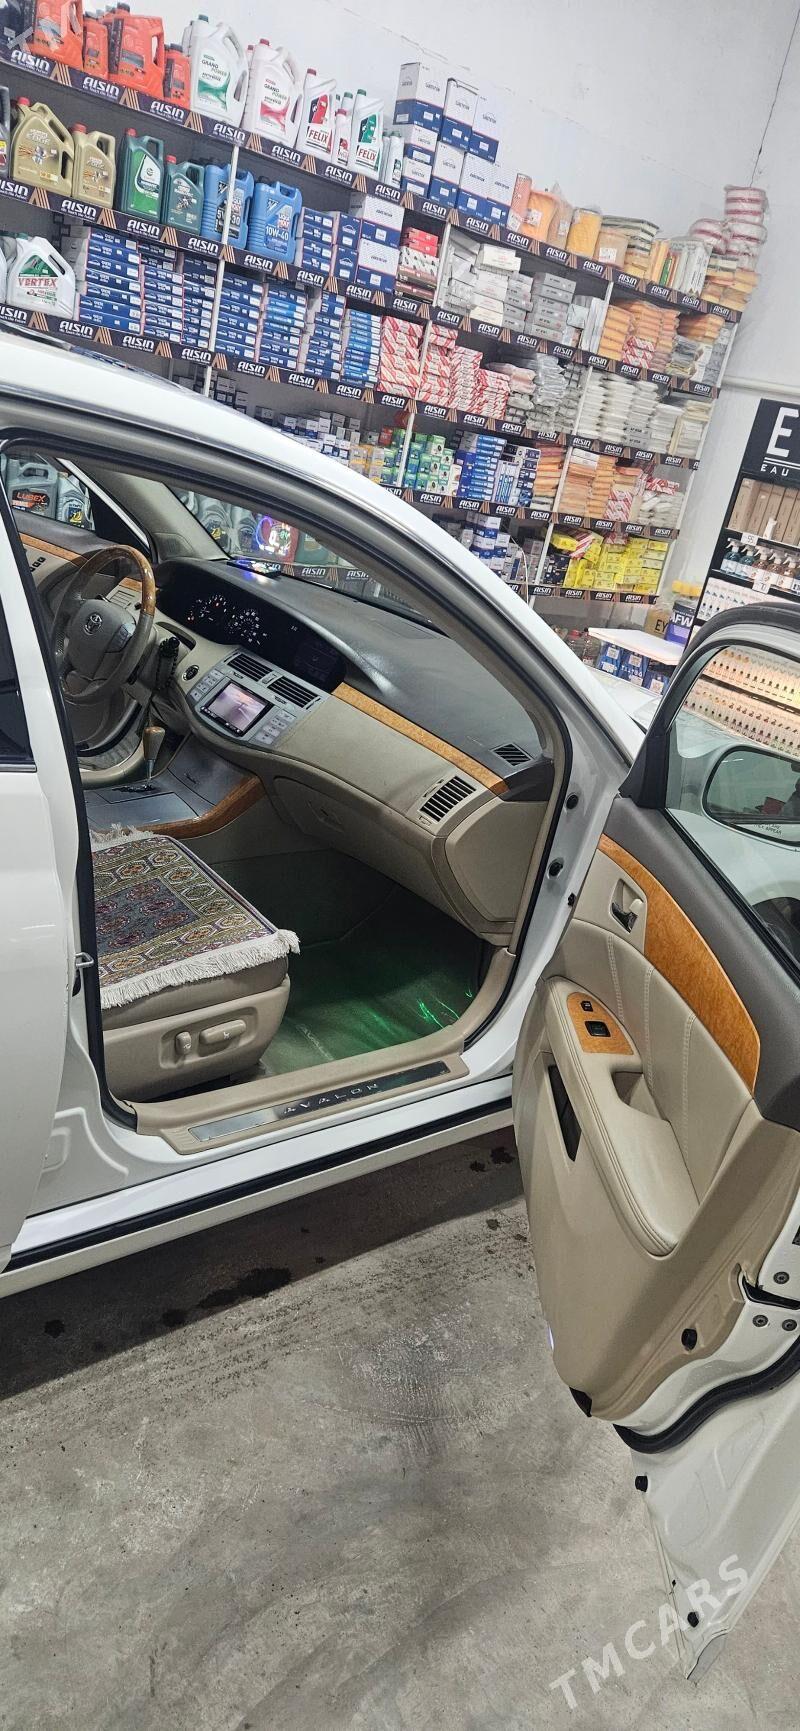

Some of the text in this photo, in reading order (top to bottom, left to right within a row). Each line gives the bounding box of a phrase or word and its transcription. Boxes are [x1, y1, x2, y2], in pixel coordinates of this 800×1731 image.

[10, 50, 51, 72] AISIN
[83, 76, 120, 96] AISIN
[151, 100, 185, 119] AISIN
[214, 123, 245, 141] AISIN
[308, 129, 328, 144] FELIX
[272, 145, 301, 163] AISIN
[359, 148, 376, 161] FELIX
[326, 165, 353, 182] AISIN
[0, 180, 28, 196] ISIN
[375, 184, 401, 200] AISIN
[62, 199, 97, 218] AISIN
[423, 202, 447, 216] AISIN
[127, 219, 160, 235] AISIN
[467, 217, 489, 231] AISIN
[266, 226, 288, 240] 10W-40
[508, 233, 529, 246] AISIN
[188, 238, 218, 253] AISIN
[547, 247, 567, 260] AISIN
[245, 255, 273, 270] AISIN
[584, 260, 603, 273] AISIN
[18, 278, 58, 288] VERTEX
[297, 270, 324, 285] AISIN
[619, 274, 637, 286] AISIN
[346, 284, 372, 298] AISIN
[652, 285, 669, 297] AISIN
[394, 298, 417, 312] AISIN
[0, 306, 27, 320] ISIN
[438, 311, 460, 324] AISIN
[60, 320, 93, 336] AISIN
[479, 323, 500, 335] AISIN
[123, 336, 154, 350] AISIN
[517, 334, 537, 346] AISIN
[182, 348, 211, 362] AISIN
[238, 361, 265, 375] AISIN
[289, 373, 315, 386] AISIN
[337, 385, 361, 397] AISIN
[382, 395, 405, 406] AISIN
[425, 404, 446, 416] AISIN
[464, 414, 485, 426] AISIN
[502, 423, 522, 433] AISIN
[766, 406, 800, 458] E
[760, 464, 790, 476] EAU
[16, 492, 46, 502] LUBEX
[420, 493, 442, 503] AISIN
[460, 501, 479, 510] AISIN
[496, 506, 515, 515] AISIN
[531, 511, 550, 520] AISIN
[564, 515, 581, 525] AISIN
[283, 1083, 378, 1114] AVALON
